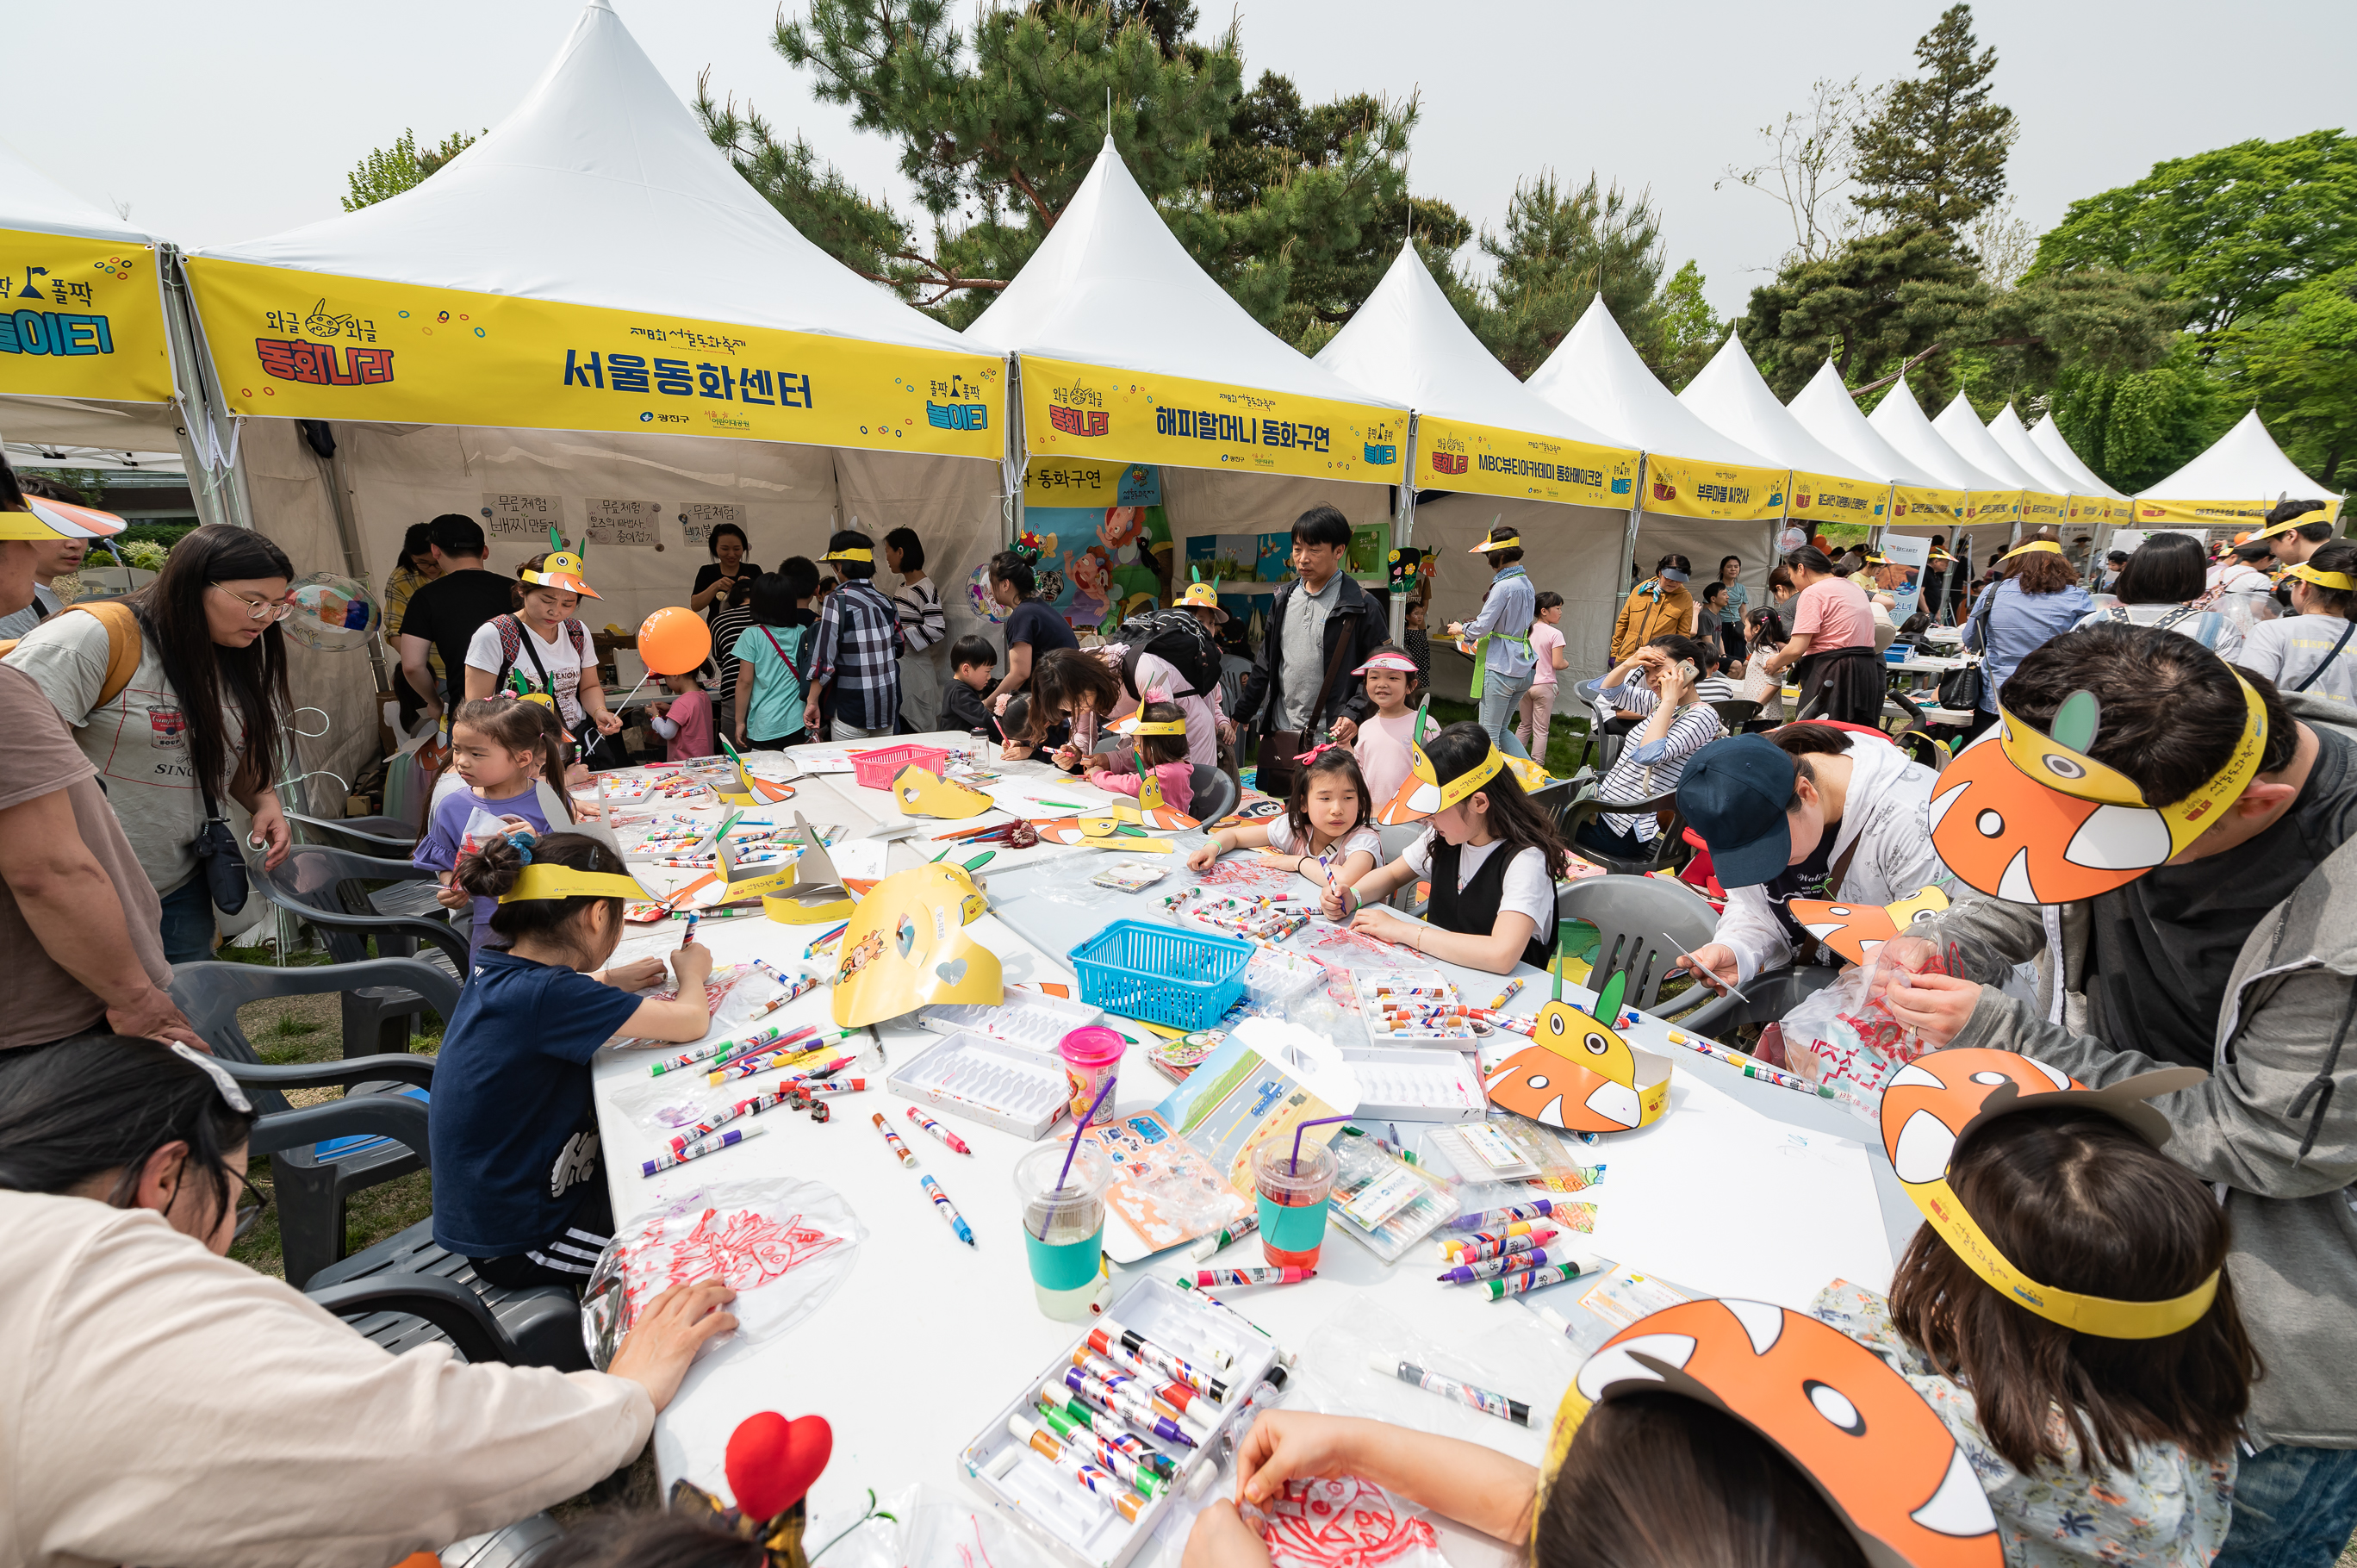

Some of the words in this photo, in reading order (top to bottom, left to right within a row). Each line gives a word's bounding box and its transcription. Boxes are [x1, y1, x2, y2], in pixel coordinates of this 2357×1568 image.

[52, 278, 93, 308] 폴짝
[265, 310, 300, 334] 와글
[345, 319, 376, 343] 와글
[669, 328, 746, 355] 서울동화축제
[255, 337, 395, 386] 동화나라
[564, 349, 813, 408] 서울동화센터
[930, 380, 948, 397] 폴짝
[963, 384, 979, 400] 폴짝
[1053, 387, 1067, 403] 와글
[1088, 391, 1102, 408] 와글
[657, 414, 690, 423] 광진구
[926, 400, 988, 431] 놀이터
[1049, 404, 1110, 437] 동화나라
[1155, 406, 1257, 445] 해피할머니
[1261, 419, 1330, 453] 동화구연
[1364, 441, 1396, 465] 놀이터
[1433, 451, 1468, 475] 동화나라
[1038, 469, 1101, 488] 동화구연
[1478, 454, 1555, 480] MBC뷰티아카데미
[1557, 464, 1602, 488] 동화메이크업
[1697, 483, 1727, 502] 부루마불
[1729, 485, 1750, 504] 씨앗사
[590, 515, 615, 528] 오즈의
[616, 530, 653, 543] 종이접기
